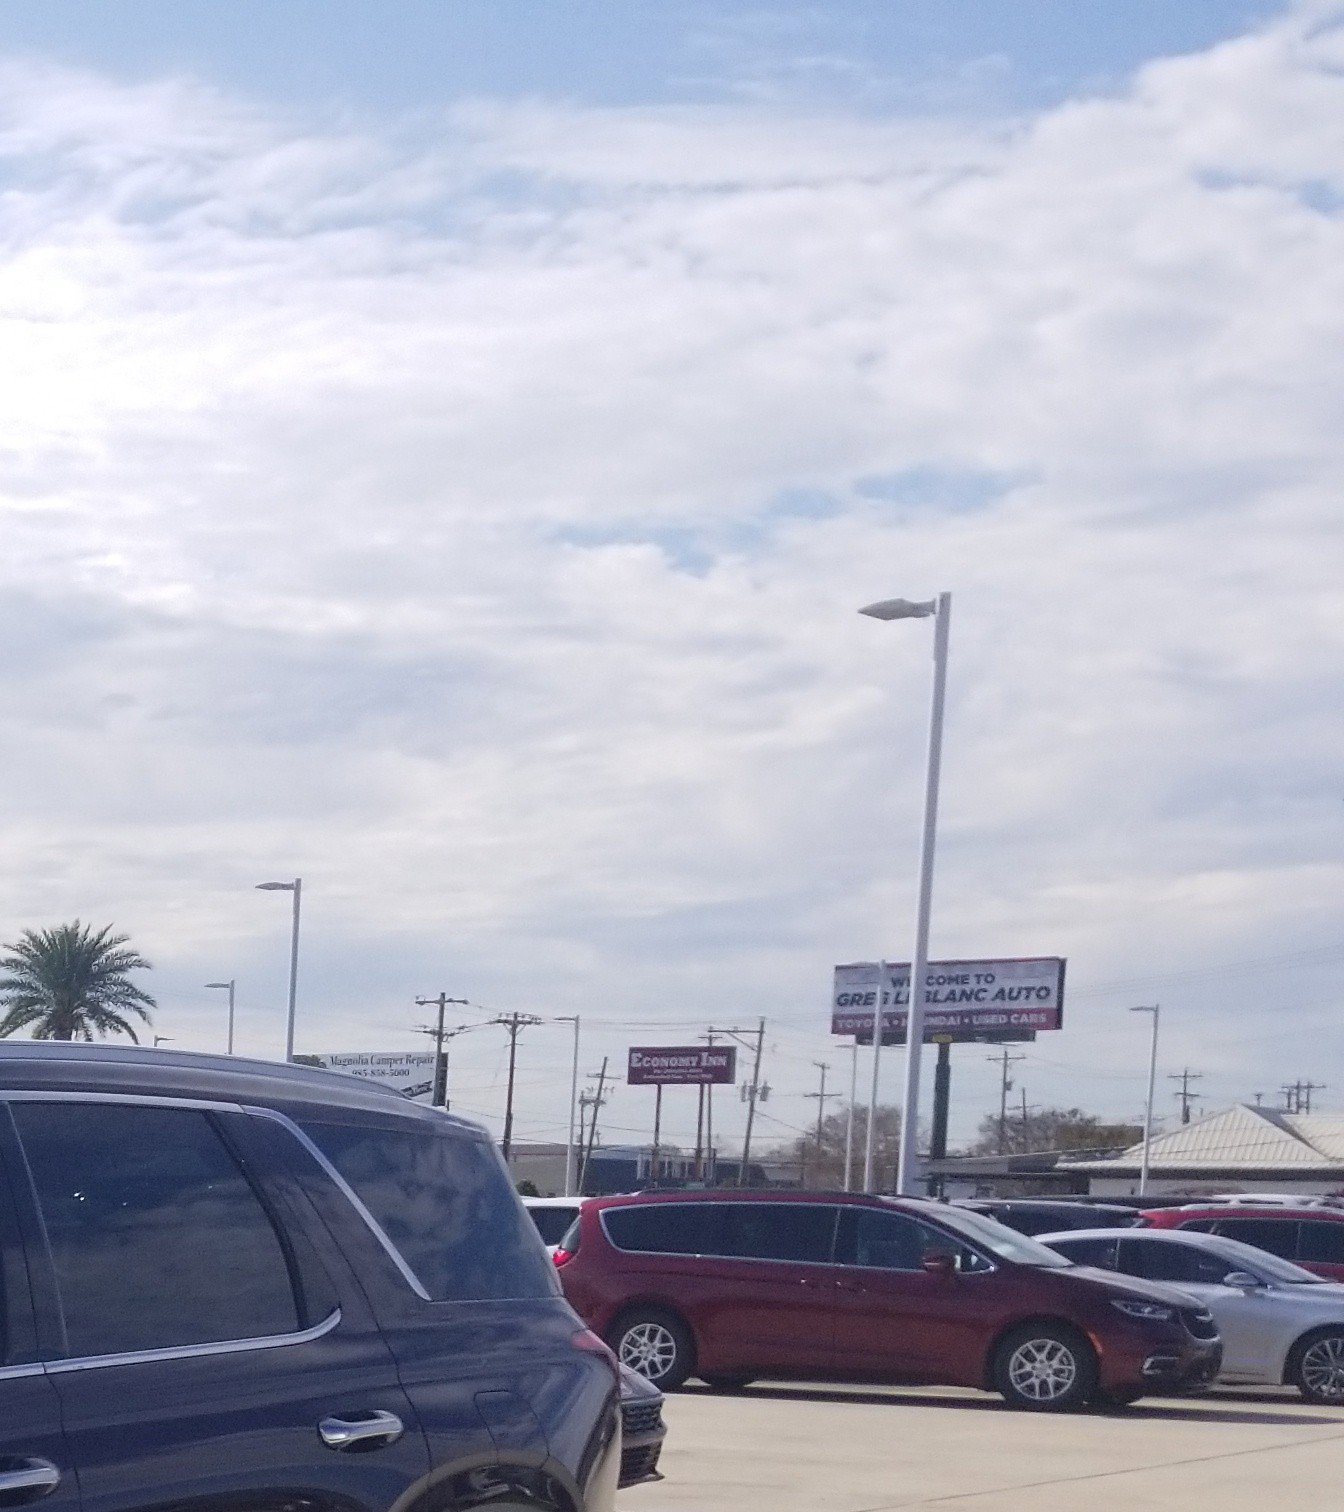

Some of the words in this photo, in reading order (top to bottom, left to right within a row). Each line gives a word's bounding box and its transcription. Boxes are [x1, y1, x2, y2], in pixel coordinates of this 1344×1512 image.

[974, 972, 996, 985] TO
[991, 985, 1051, 1003] AUTO
[972, 1013, 1007, 1026] USED
[1010, 1012, 1048, 1025] CARS
[330, 1055, 369, 1067] Magnolia
[370, 1054, 404, 1068] Camper
[405, 1054, 435, 1067] Repair
